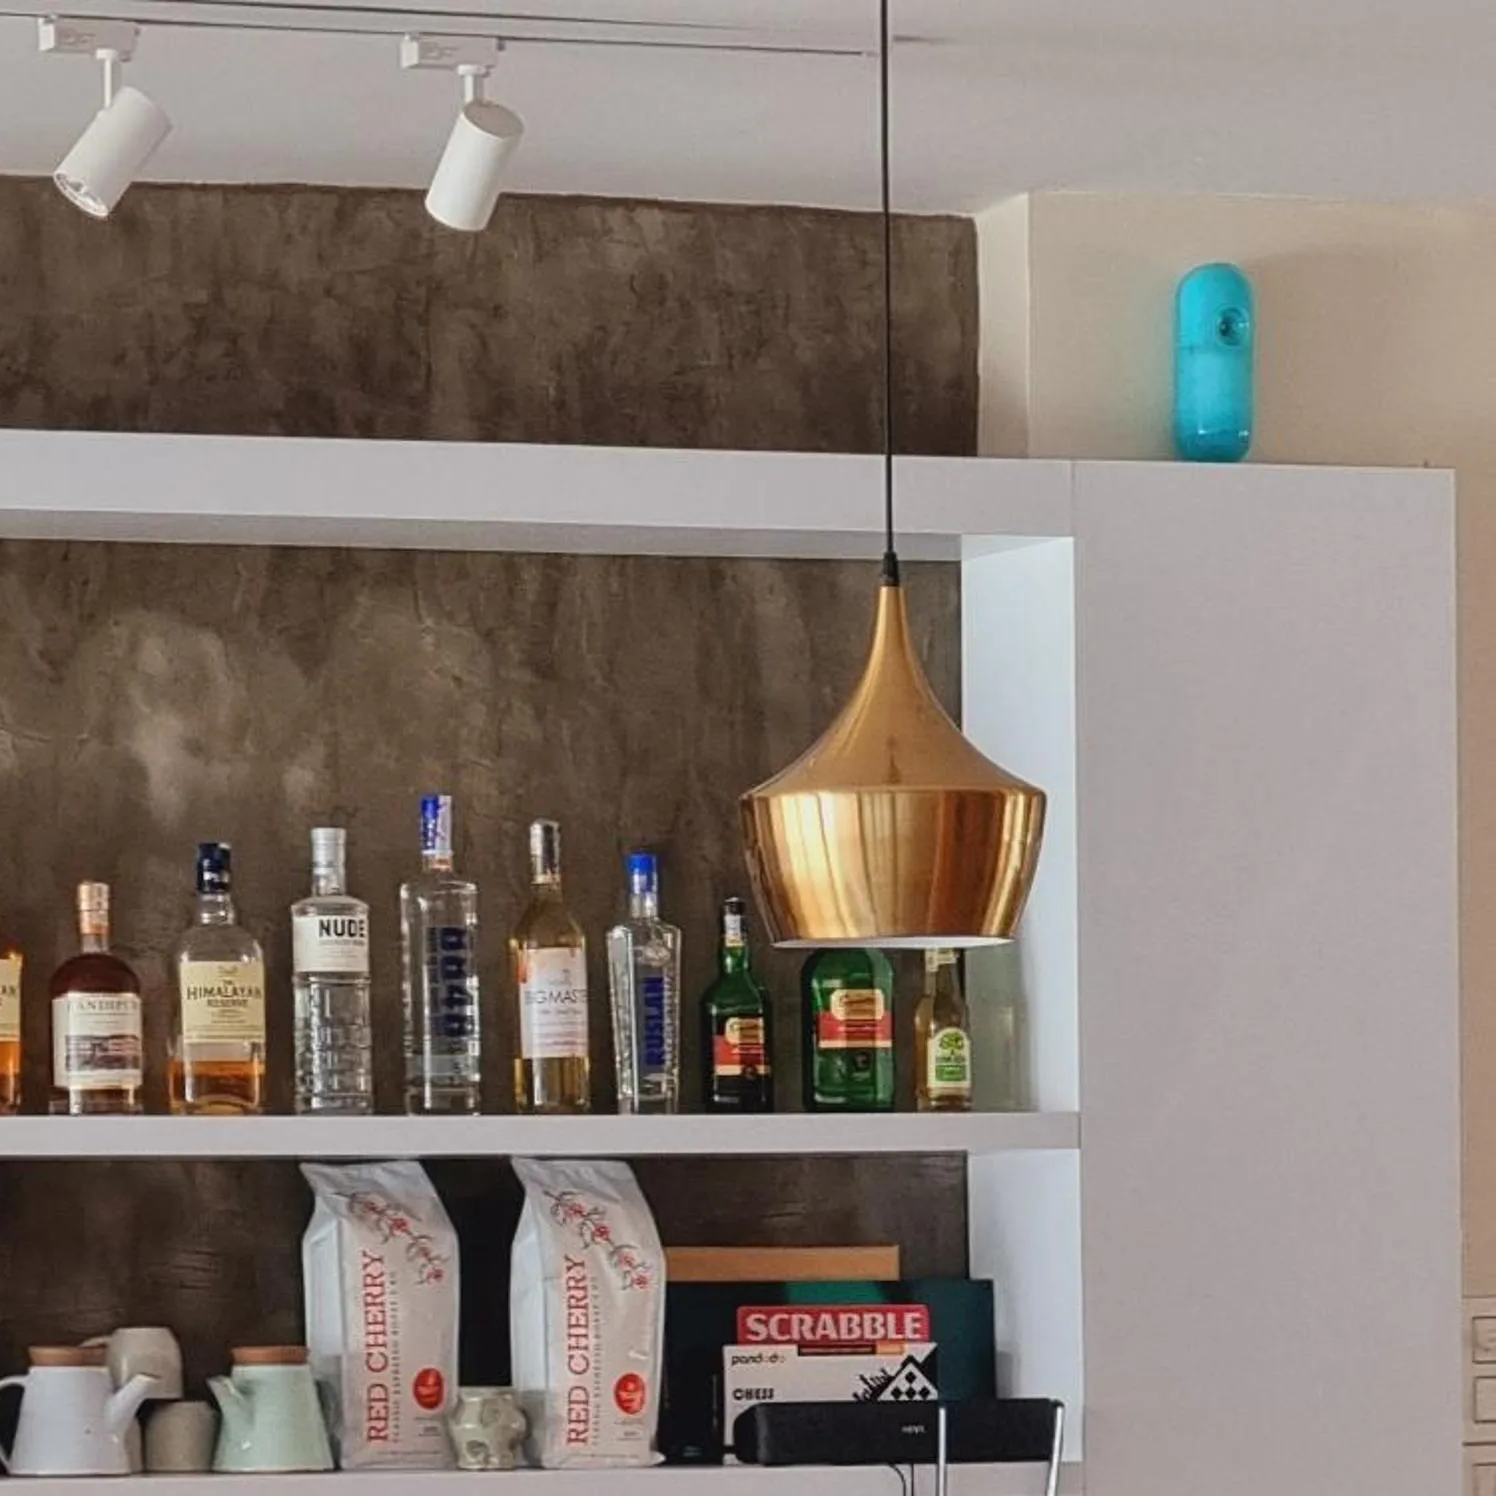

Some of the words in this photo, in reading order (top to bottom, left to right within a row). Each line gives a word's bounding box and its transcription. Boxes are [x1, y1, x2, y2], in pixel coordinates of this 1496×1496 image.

[319, 918, 365, 937] NUDE
[186, 986, 261, 1000] HIMALAYAN
[362, 1250, 389, 1373] CHERRY
[564, 1255, 589, 1375] CHERRY
[745, 1311, 922, 1341] SCRABBLE
[366, 1383, 389, 1442] RED
[566, 1386, 589, 1444] RED
[732, 1388, 774, 1400] CHESS
